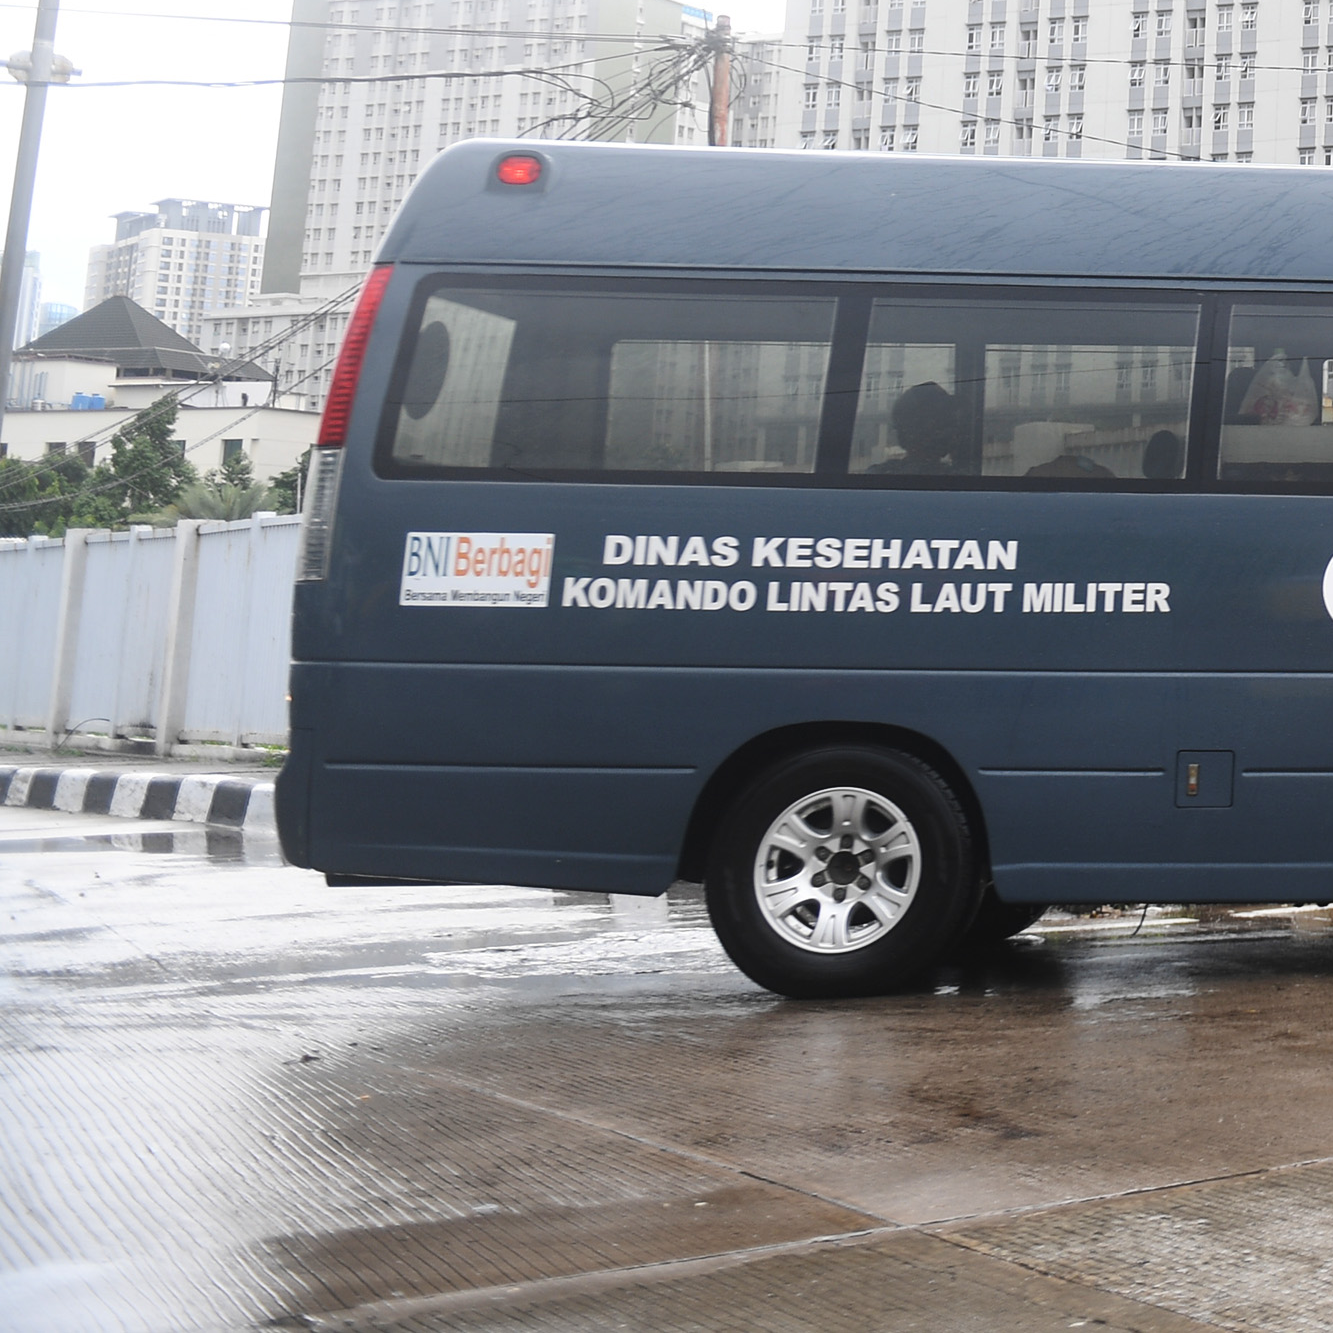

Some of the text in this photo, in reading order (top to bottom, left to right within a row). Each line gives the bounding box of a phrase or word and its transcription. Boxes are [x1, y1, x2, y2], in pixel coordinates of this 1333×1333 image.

[405, 536, 552, 588] BNI Berbagi
[602, 535, 1019, 570] DINAS KESEHATAN
[404, 589, 448, 602] Bersama
[451, 589, 511, 605] Membangun
[561, 577, 1171, 613] KOMANDO LINTAS LAUT MILITER
